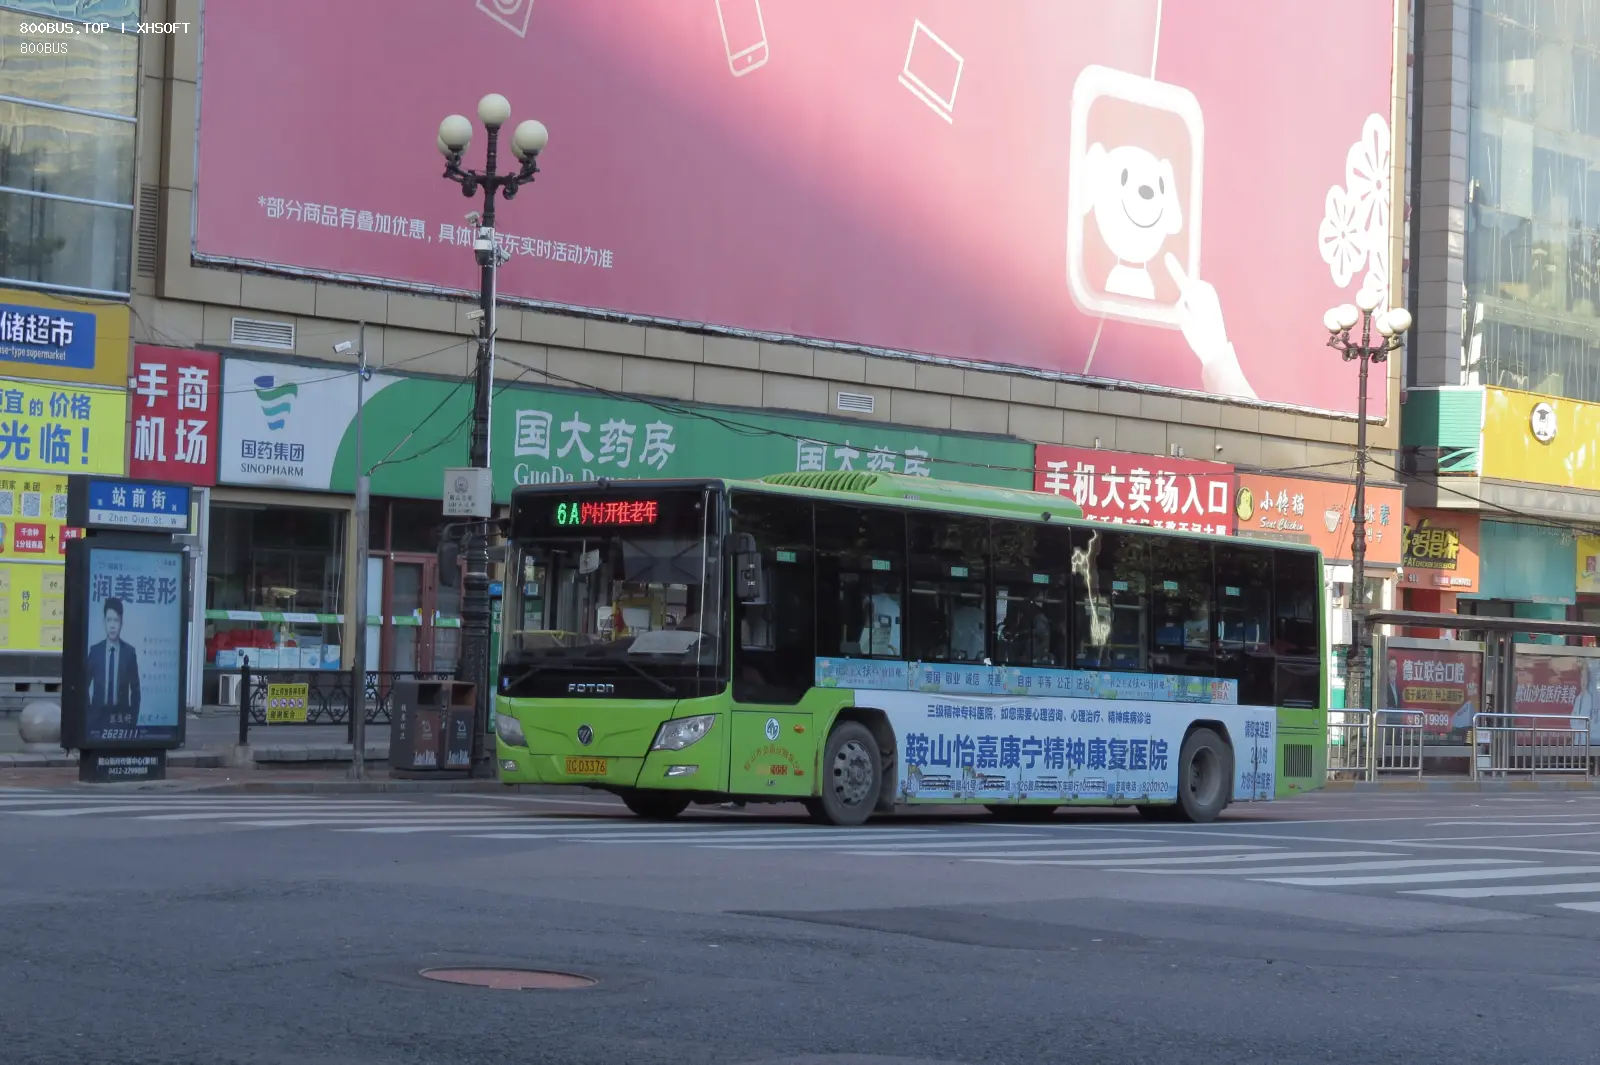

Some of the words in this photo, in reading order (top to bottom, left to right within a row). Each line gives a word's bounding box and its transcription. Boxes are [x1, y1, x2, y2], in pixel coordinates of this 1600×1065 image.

[0, 311, 74, 347] 储超市
[27, 348, 66, 361] supermarket
[241, 439, 305, 462] 国药集团
[514, 409, 676, 471] 国大药房
[240, 462, 304, 477] SINOPHARM
[513, 462, 574, 485] GuoDa
[24, 481, 41, 492] 美团
[1043, 460, 1229, 516] 手机大卖场入口
[112, 487, 166, 510] 站前街
[97, 513, 102, 521] E
[109, 513, 128, 522] Zhan
[132, 514, 149, 524] Qian
[557, 502, 580, 525] 6A
[1278, 518, 1305, 532] Chicken
[92, 573, 177, 604] 润美整形
[925, 671, 941, 684] 爱国
[945, 672, 960, 685] 敬业
[965, 672, 980, 686] 诚信
[987, 673, 1001, 687] 友善
[1017, 675, 1032, 688] 自由
[1038, 676, 1051, 689] 平等
[1057, 677, 1072, 690] 公正
[1076, 677, 1091, 691] 法治
[1402, 659, 1465, 684] 德立联合口腔
[568, 683, 615, 693] FOTON
[101, 728, 139, 739] 2623111
[905, 732, 1169, 772] 鞍山怡嘉康宁精神康复医院
